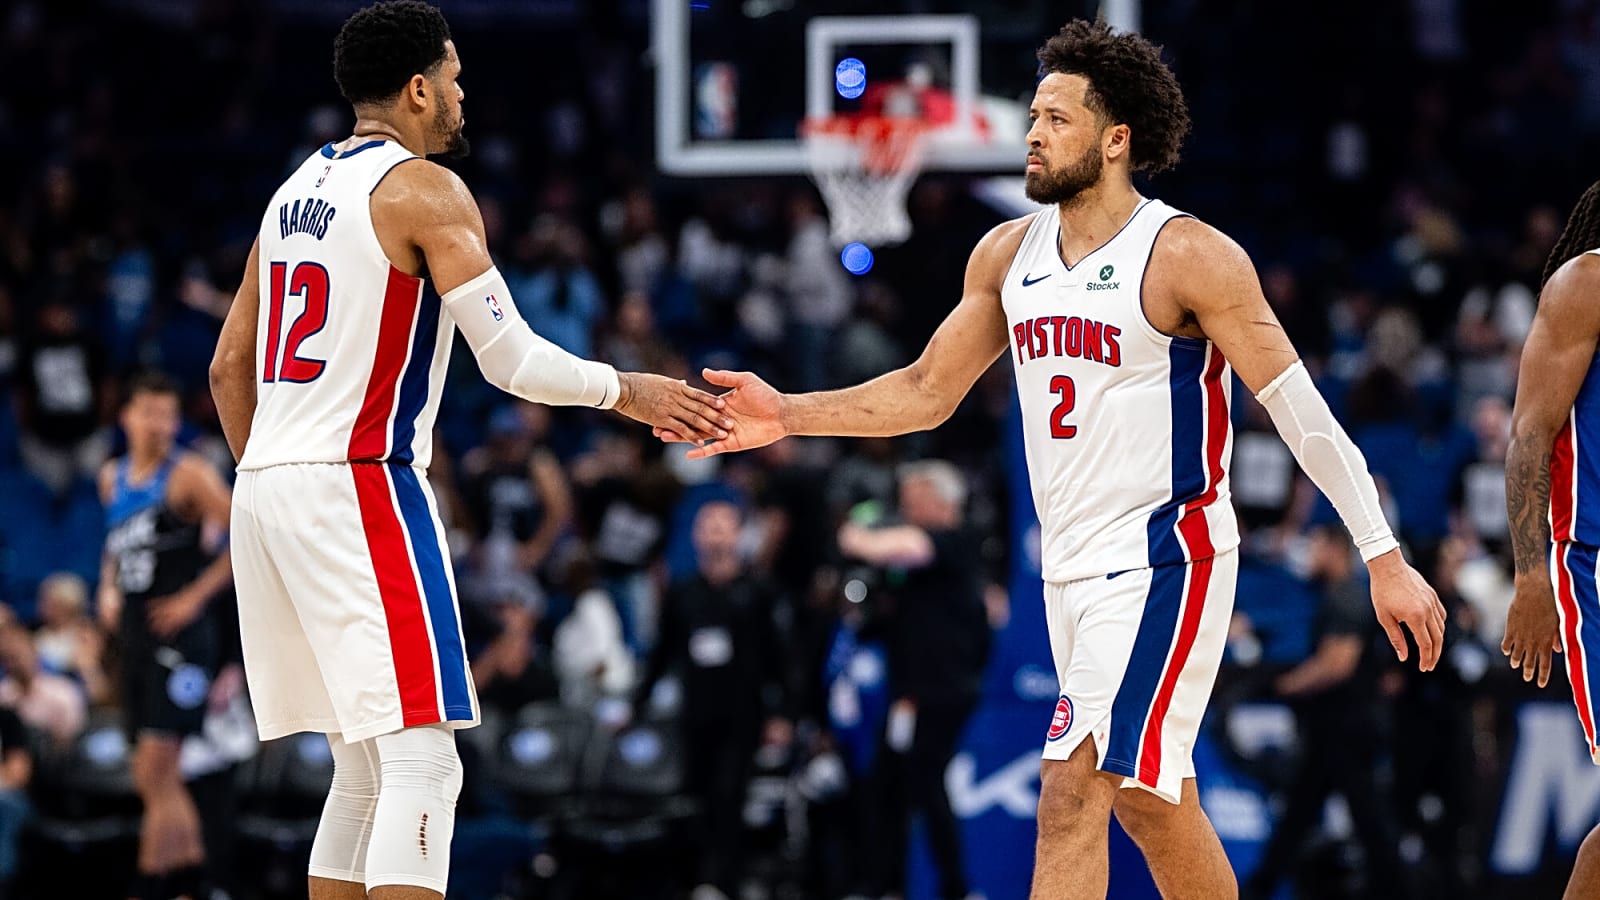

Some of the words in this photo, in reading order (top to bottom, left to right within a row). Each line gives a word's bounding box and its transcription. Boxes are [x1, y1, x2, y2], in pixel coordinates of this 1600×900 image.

[279, 197, 336, 241] HARRIS
[1086, 281, 1120, 291] StockX
[262, 261, 330, 384] 12
[1013, 316, 1121, 368] PISTONS
[1049, 374, 1077, 440] 2
